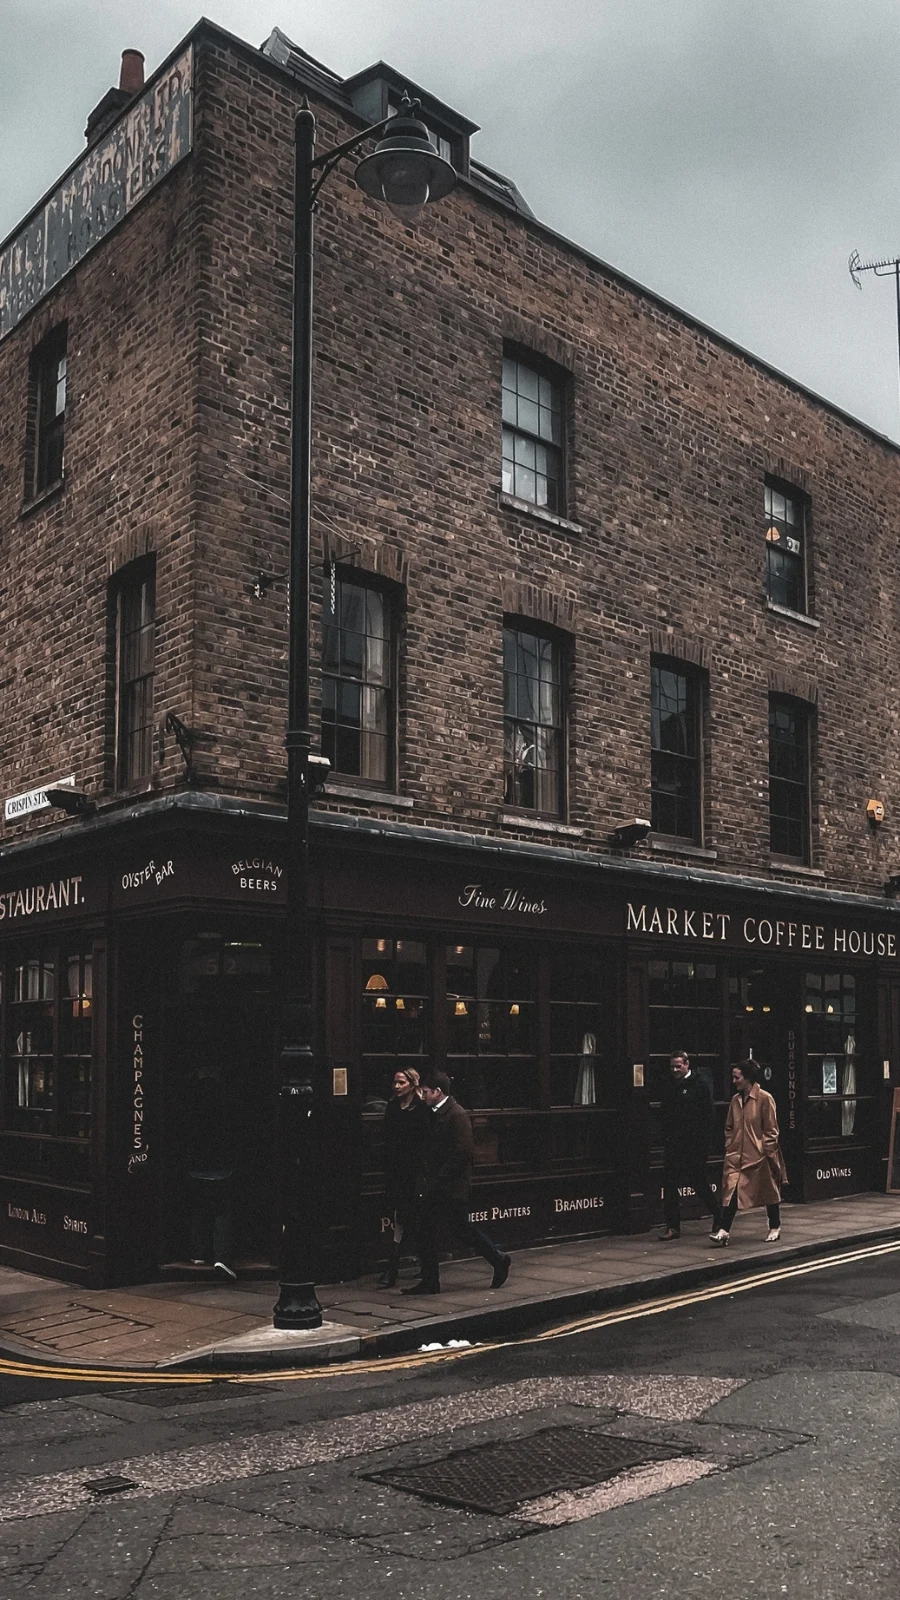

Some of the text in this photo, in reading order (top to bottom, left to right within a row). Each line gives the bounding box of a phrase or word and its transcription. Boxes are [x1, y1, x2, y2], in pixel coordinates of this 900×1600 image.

[7, 793, 33, 815] CRISPIN
[121, 860, 175, 890] OYSTER BAR
[231, 857, 283, 878] BELGIAN
[240, 877, 278, 891] BEERS
[458, 884, 548, 914] Fine Wines
[626, 903, 897, 957] MARKET COFFEE HOUSE
[132, 1014, 144, 1149] CHAMPAGNES
[788, 1030, 796, 1129] BURGUNDIES
[128, 1152, 148, 1165] AND
[816, 1167, 852, 1180] OLD WINES
[8, 1203, 47, 1225] LONDON ALES
[468, 1206, 531, 1223] EESE PLATTERS
[554, 1196, 604, 1213] BRANDIES
[63, 1215, 88, 1234] SPIRITS
